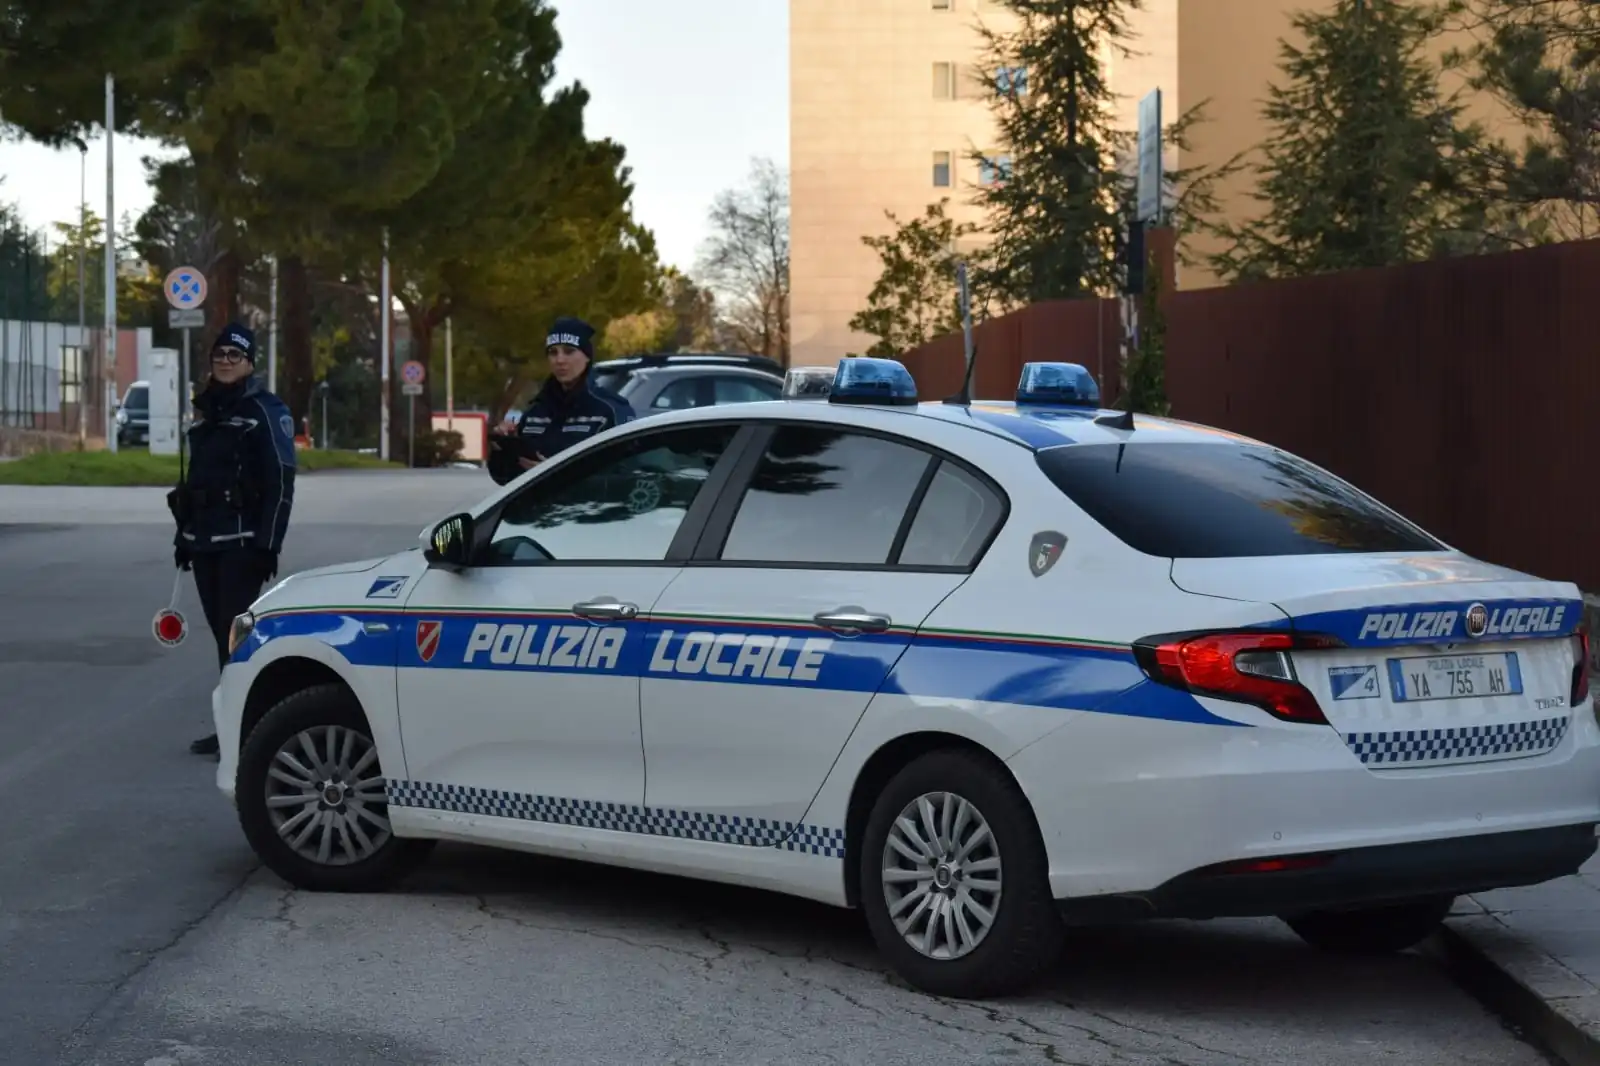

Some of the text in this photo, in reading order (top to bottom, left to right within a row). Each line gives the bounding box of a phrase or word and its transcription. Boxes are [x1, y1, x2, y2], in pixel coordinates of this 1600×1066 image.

[1358, 606, 1565, 639] POLIZIA LOCALE
[463, 623, 833, 680] POLIZIA LOCALE
[1427, 656, 1485, 671] POLIZIA LOCALE
[1364, 677, 1374, 692] 4
[1411, 668, 1505, 697] YA 755 AH
